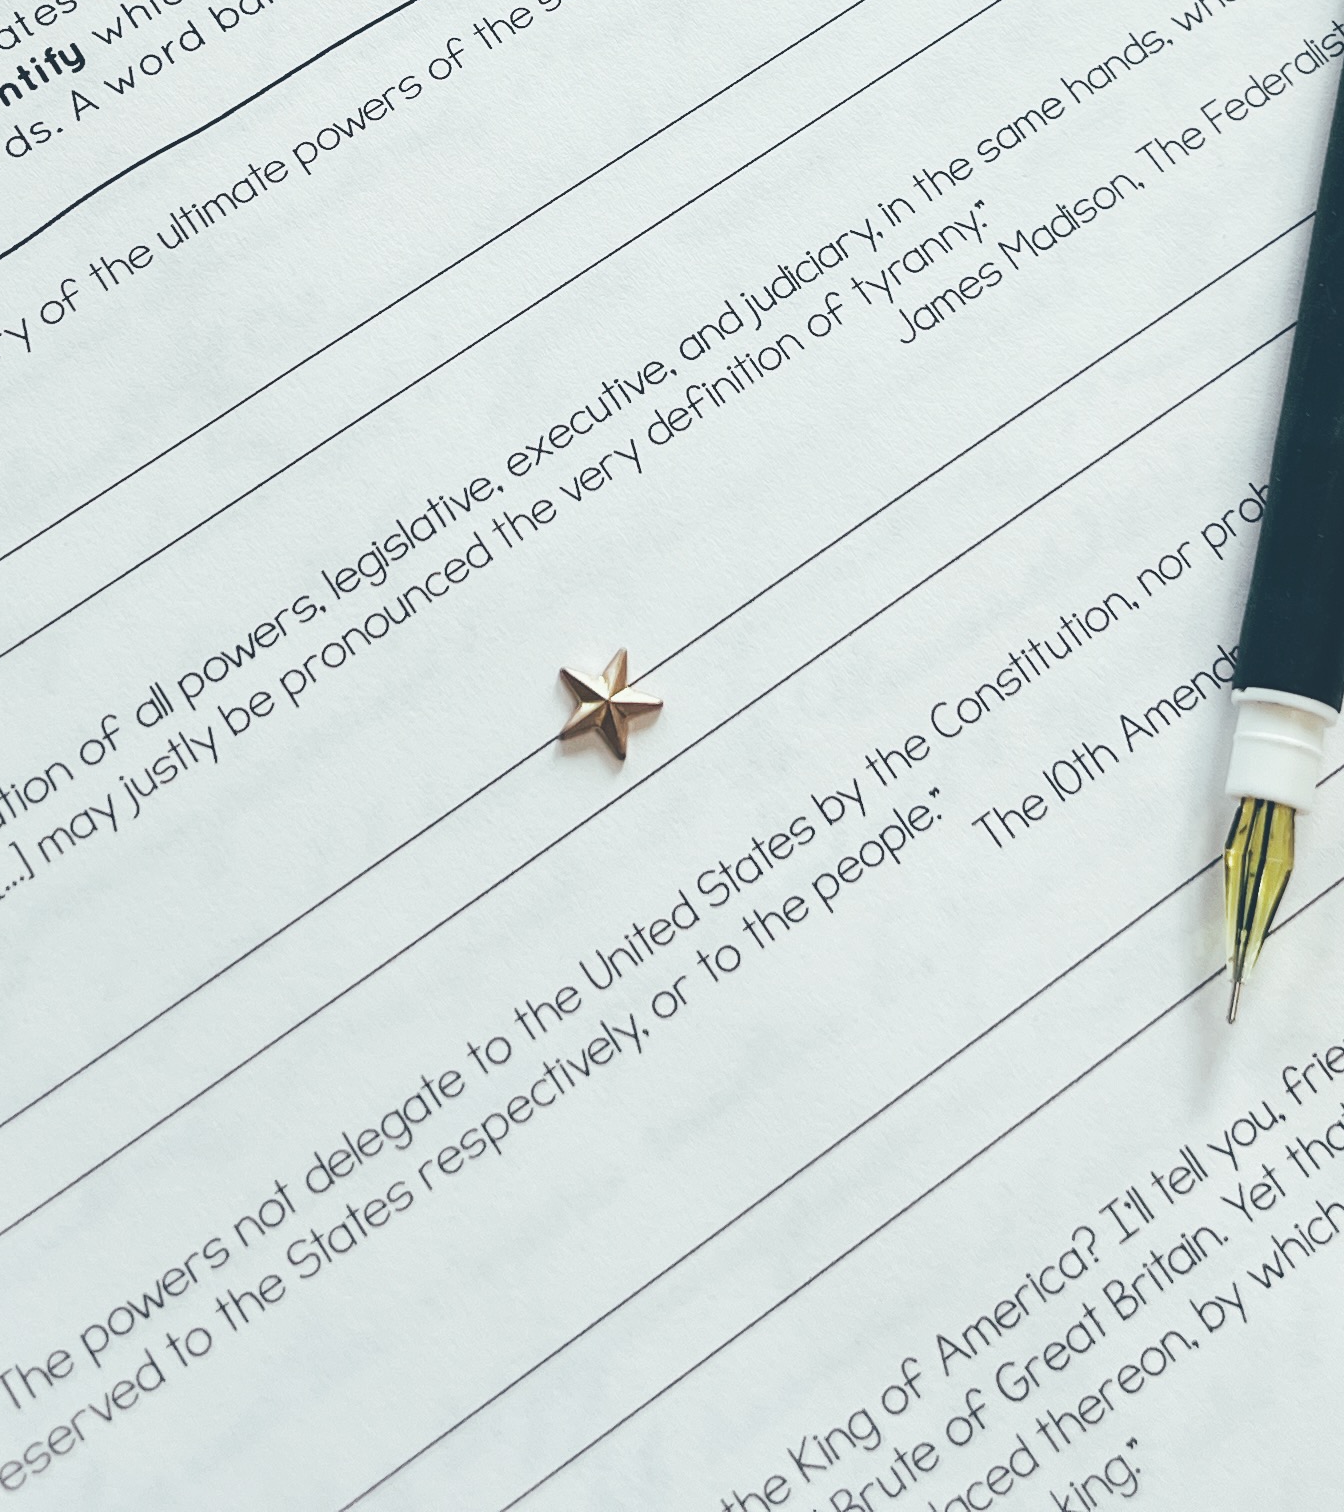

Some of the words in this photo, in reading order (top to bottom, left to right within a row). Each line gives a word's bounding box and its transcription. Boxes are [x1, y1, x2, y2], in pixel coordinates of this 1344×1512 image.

[39, 277, 80, 326] of
[88, 244, 155, 292] the
[155, 159, 290, 250] ultimate
[291, 74, 424, 177] powers
[427, 36, 466, 82] of
[472, 6, 535, 51] the
[70, 89, 101, 123] A
[102, 18, 207, 96] word
[897, 261, 1004, 345] James
[996, 173, 1146, 272] Madison,
[1133, 126, 1207, 174] The
[78, 712, 121, 767] of
[135, 680, 175, 729] all
[176, 594, 328, 712] powers,
[320, 476, 505, 601] legislative,
[506, 360, 678, 478] executive,
[678, 298, 745, 362] and
[738, 217, 885, 332] judiciary,
[876, 197, 917, 228] in
[911, 157, 975, 203] the
[976, 96, 1067, 164] same
[1059, 29, 1175, 105] hands,
[36, 792, 119, 864] may
[117, 725, 219, 821] justly
[216, 690, 276, 738] be
[278, 530, 495, 709] pronounced
[490, 498, 558, 549] the
[558, 437, 643, 503] very
[646, 333, 806, 447] definition
[806, 290, 844, 339] of
[79, 1236, 231, 1370] powers
[232, 1178, 297, 1249] not
[304, 1069, 467, 1196] delegate
[466, 1035, 513, 1076] to
[513, 985, 583, 1042] the
[577, 888, 701, 992] United
[696, 815, 817, 910] States
[809, 776, 867, 827] by
[864, 734, 931, 788] the
[929, 591, 1141, 739] Constitution,
[1135, 540, 1193, 598] nor
[970, 793, 1049, 850] The
[1041, 741, 1121, 803] 10th
[786, 1407, 883, 1485] King
[880, 1356, 922, 1417] of
[935, 1224, 1101, 1378] America?
[1097, 1184, 1156, 1246] I'll
[1149, 1143, 1210, 1206] tell
[1205, 1099, 1288, 1173] you,
